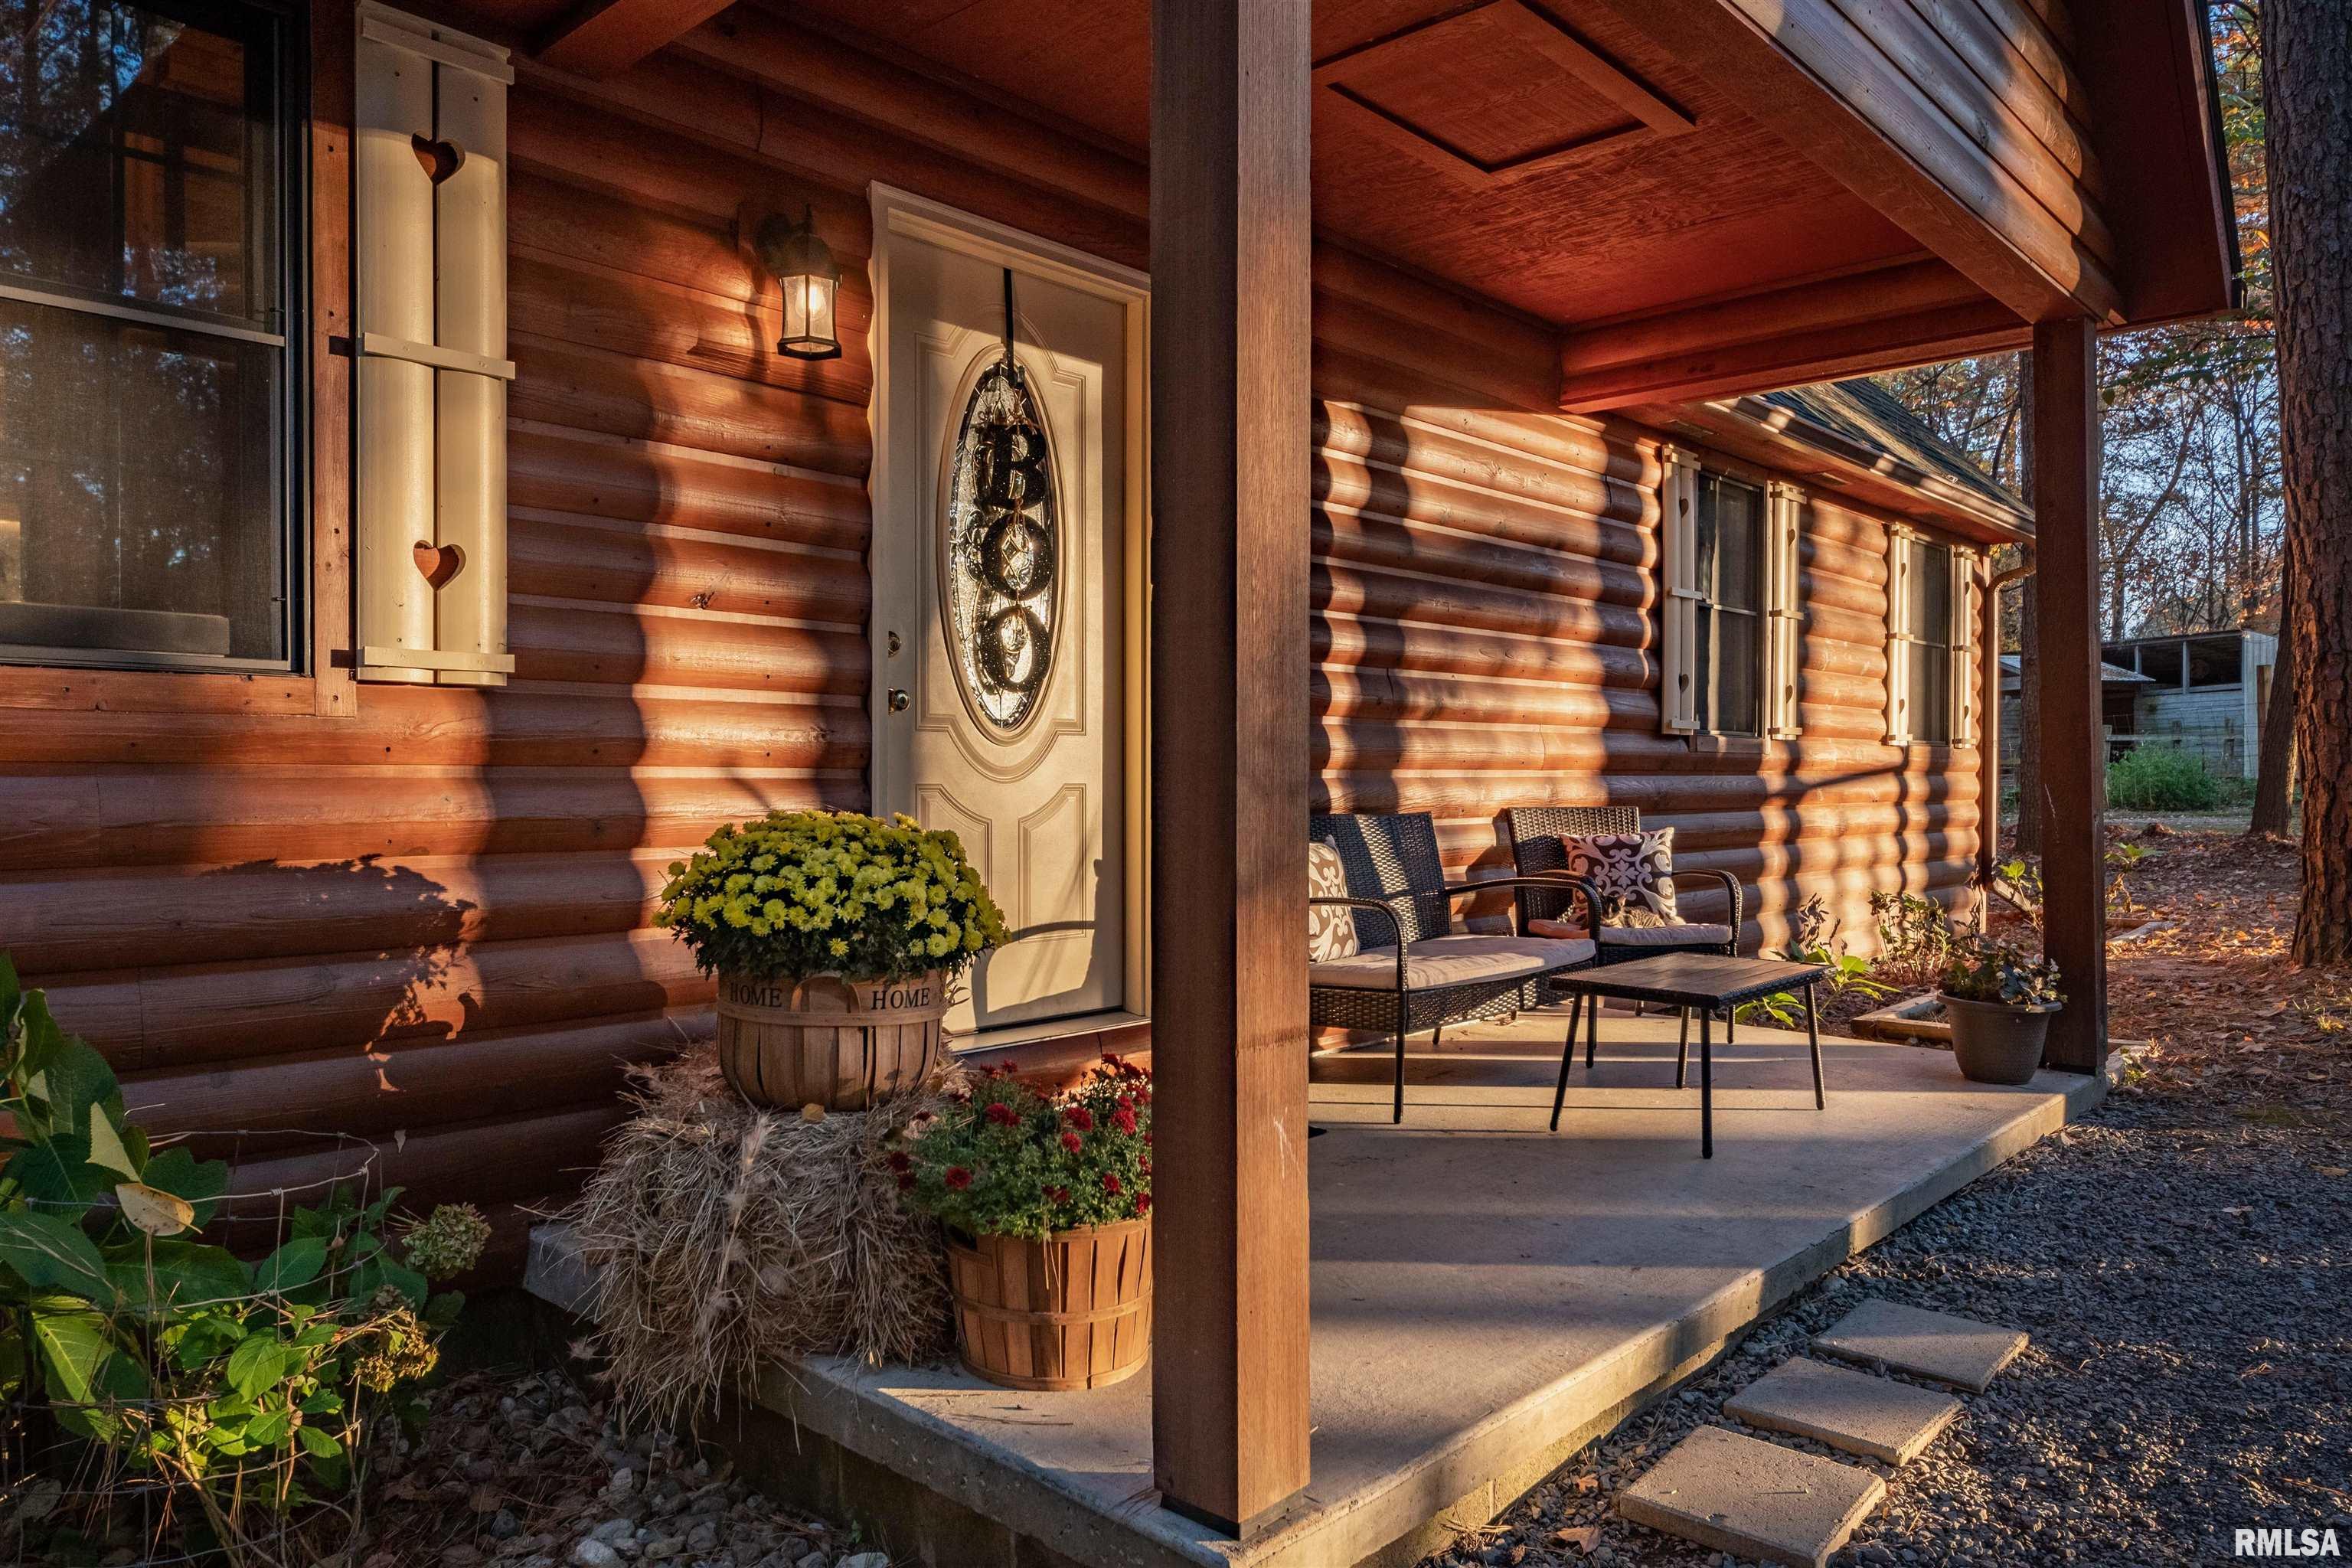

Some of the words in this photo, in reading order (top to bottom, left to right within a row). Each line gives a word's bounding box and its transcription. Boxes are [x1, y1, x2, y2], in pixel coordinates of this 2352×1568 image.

[980, 423, 1054, 692] BOO
[730, 982, 782, 1008] HOME
[871, 987, 930, 1010] HOME
